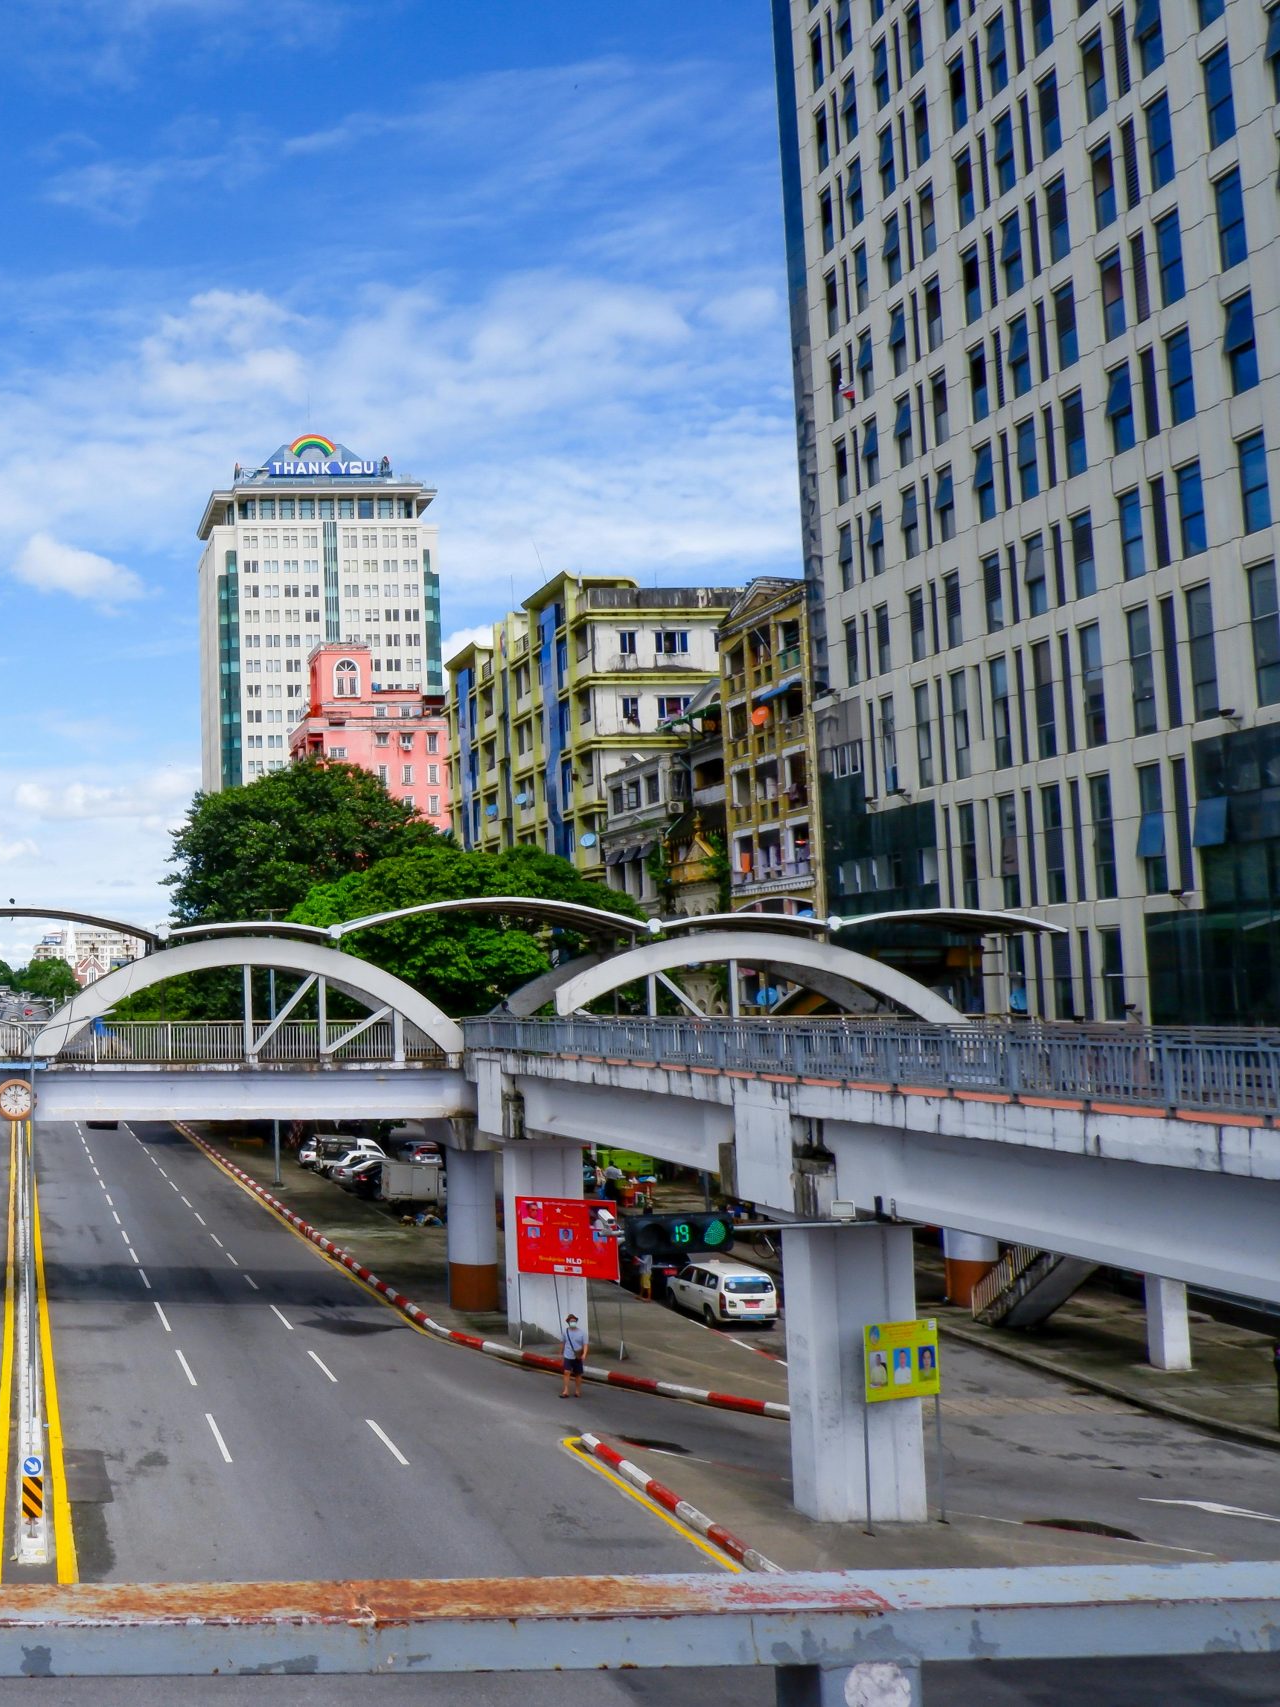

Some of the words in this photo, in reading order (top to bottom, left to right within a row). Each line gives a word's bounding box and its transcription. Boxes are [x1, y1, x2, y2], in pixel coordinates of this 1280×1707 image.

[273, 461, 331, 474] THANK
[338, 461, 374, 474] YOU
[675, 1224, 690, 1242] 19
[565, 1257, 582, 1265] NLD
